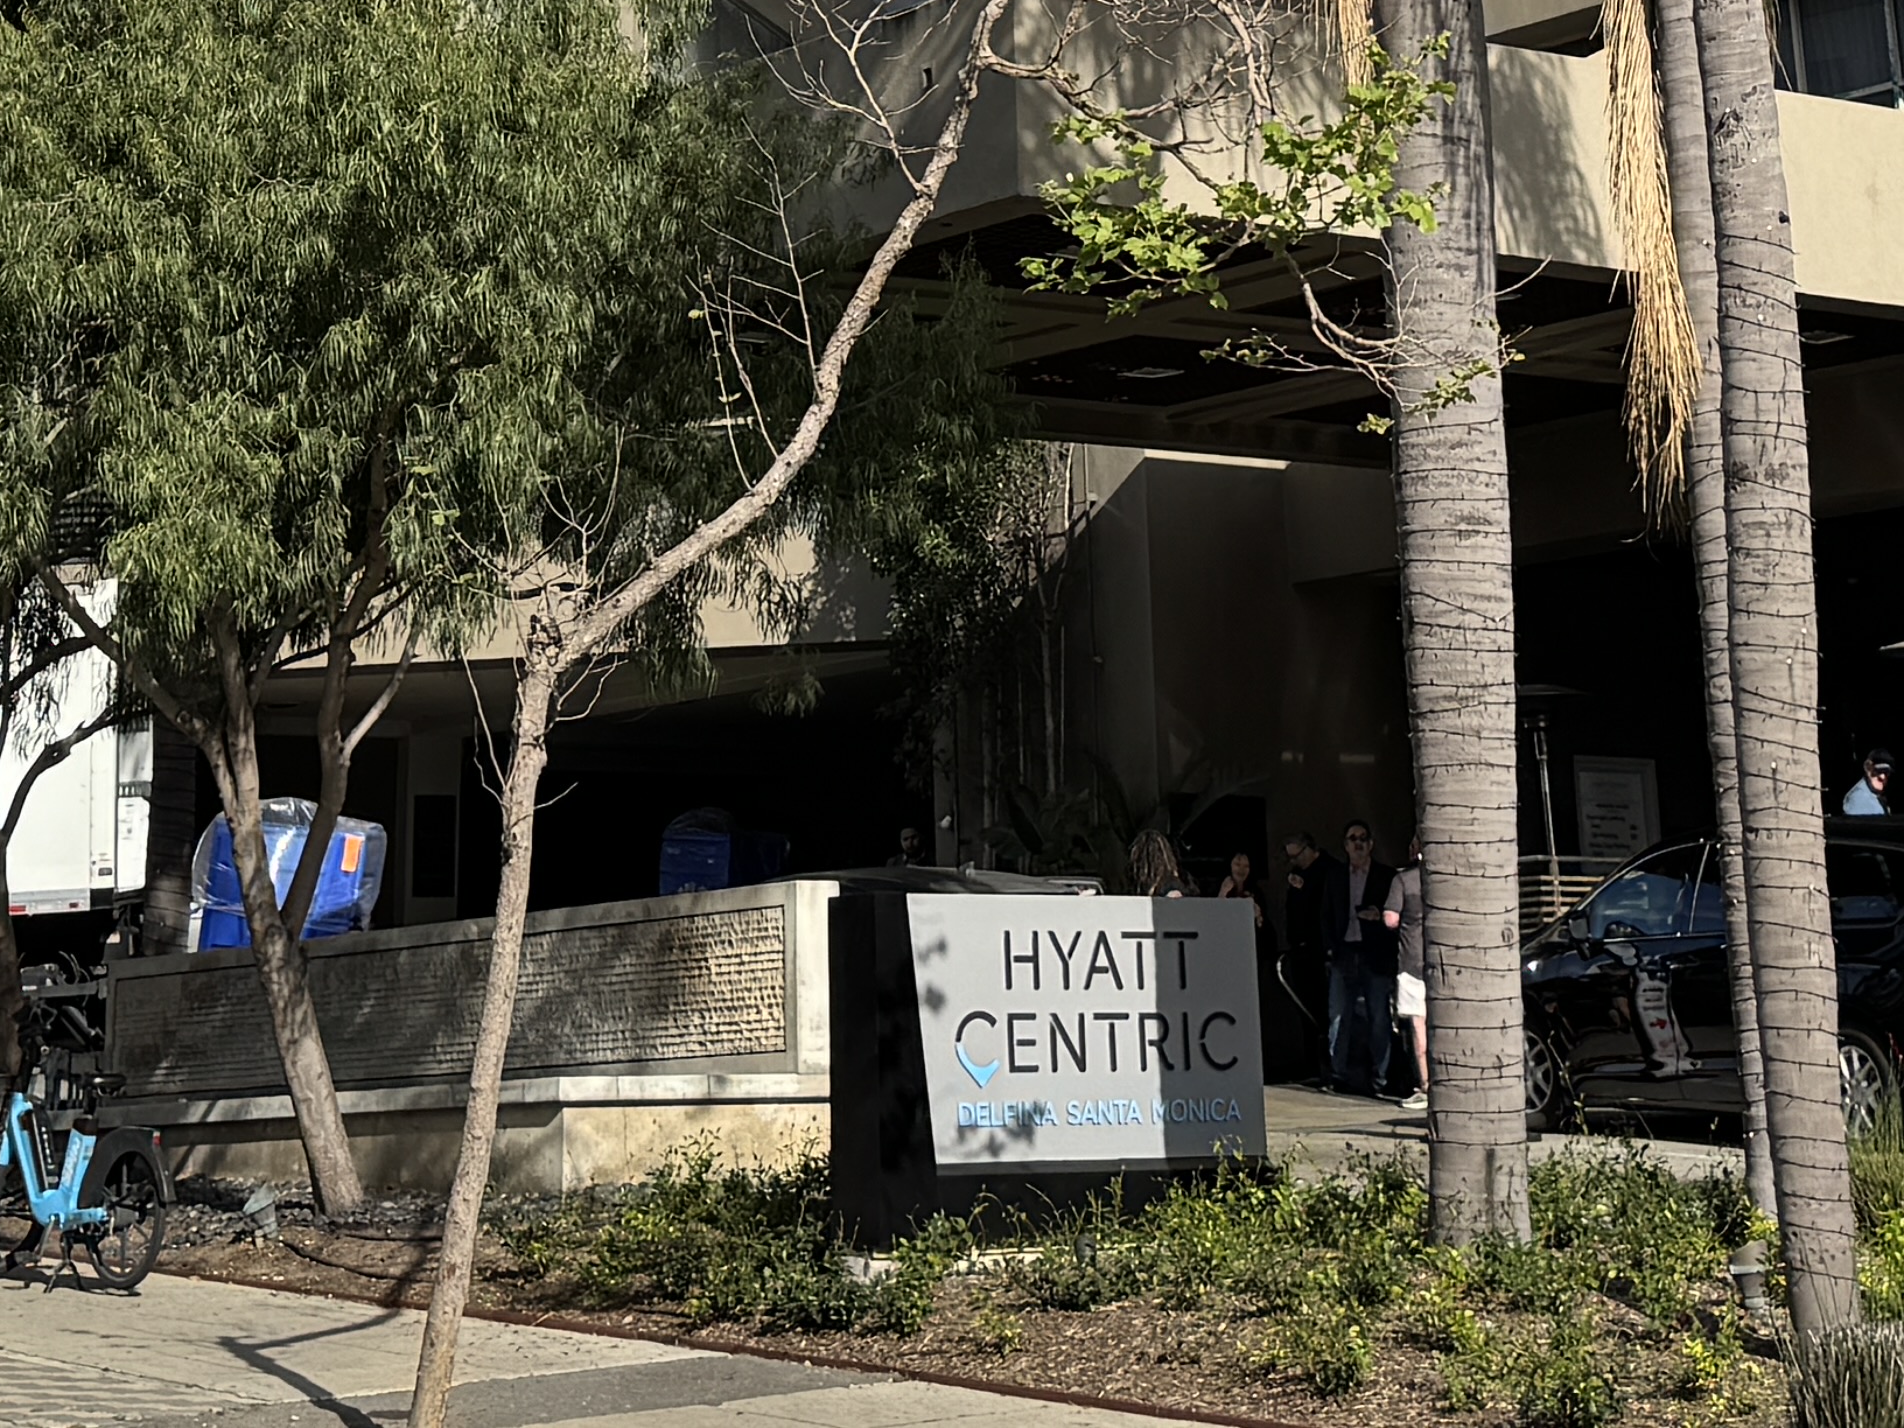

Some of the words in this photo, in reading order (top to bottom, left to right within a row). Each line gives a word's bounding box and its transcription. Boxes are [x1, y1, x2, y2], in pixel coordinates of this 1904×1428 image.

[1004, 930, 1198, 990] HYATT
[955, 1010, 1238, 1088] CENTRIC
[958, 1100, 1058, 1128] DELFINA
[1066, 1099, 1142, 1127] SANTA
[1152, 1098, 1242, 1126] MONICA
